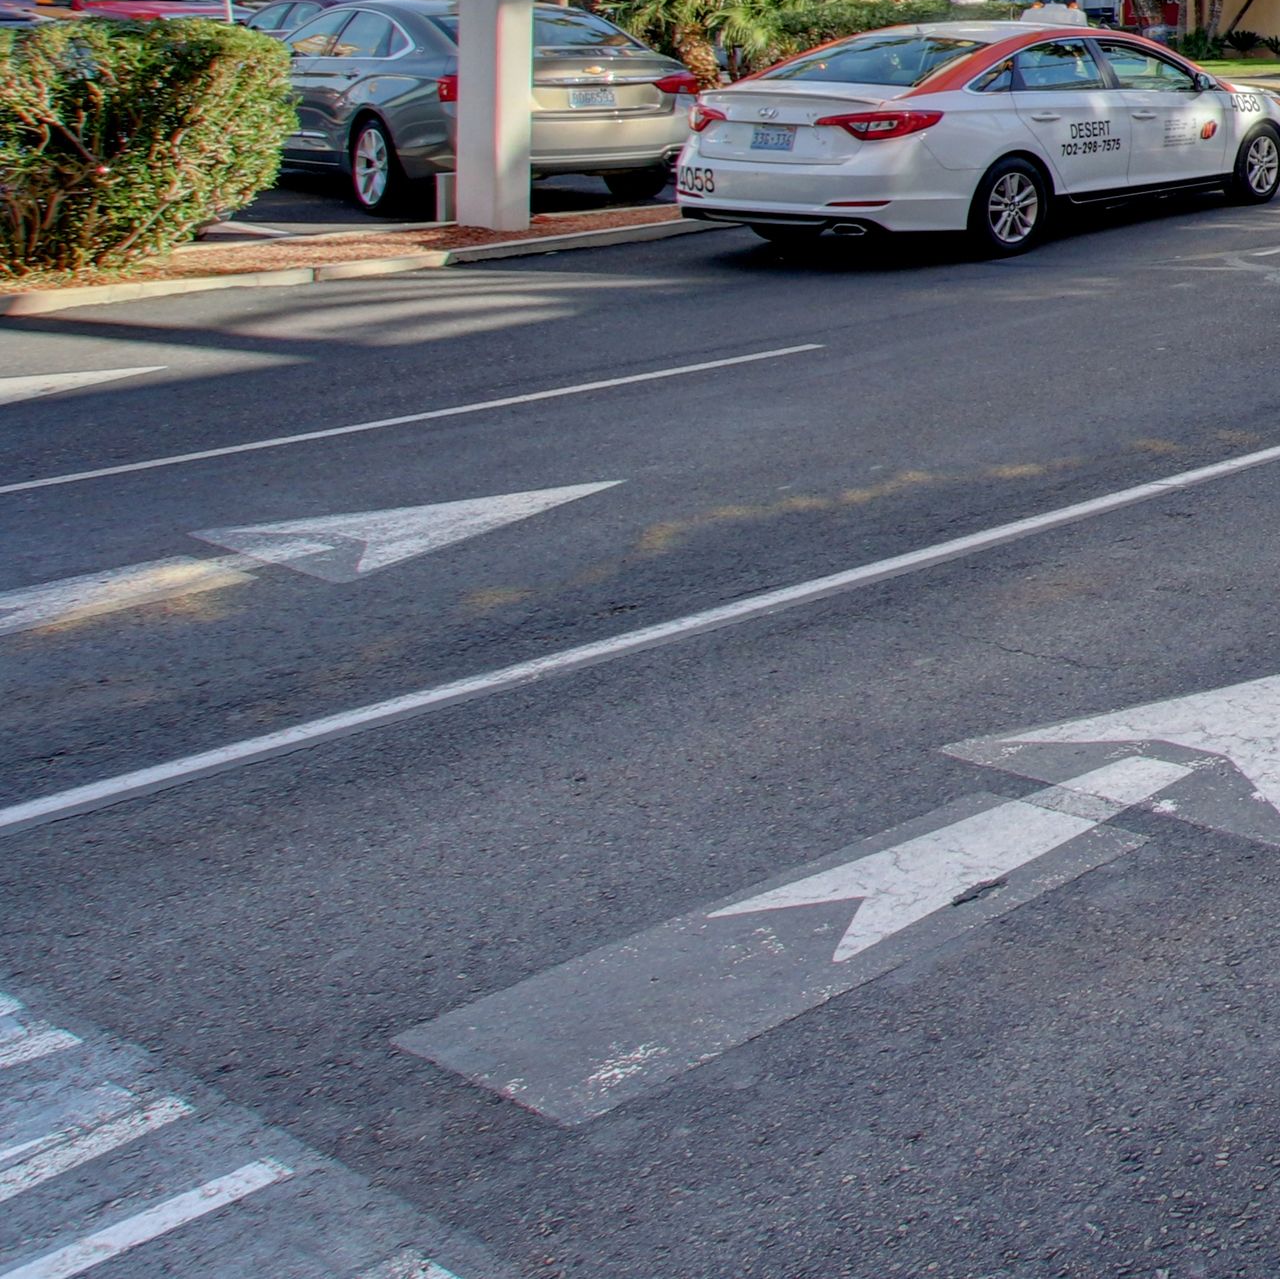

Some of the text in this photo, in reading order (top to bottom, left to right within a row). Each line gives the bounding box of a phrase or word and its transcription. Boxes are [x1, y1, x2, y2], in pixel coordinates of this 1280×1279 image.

[1230, 94, 1260, 112] 4058
[1069, 120, 1112, 140] DESERT
[1060, 138, 1121, 157] 702-298-7575
[679, 166, 715, 193] 4058
